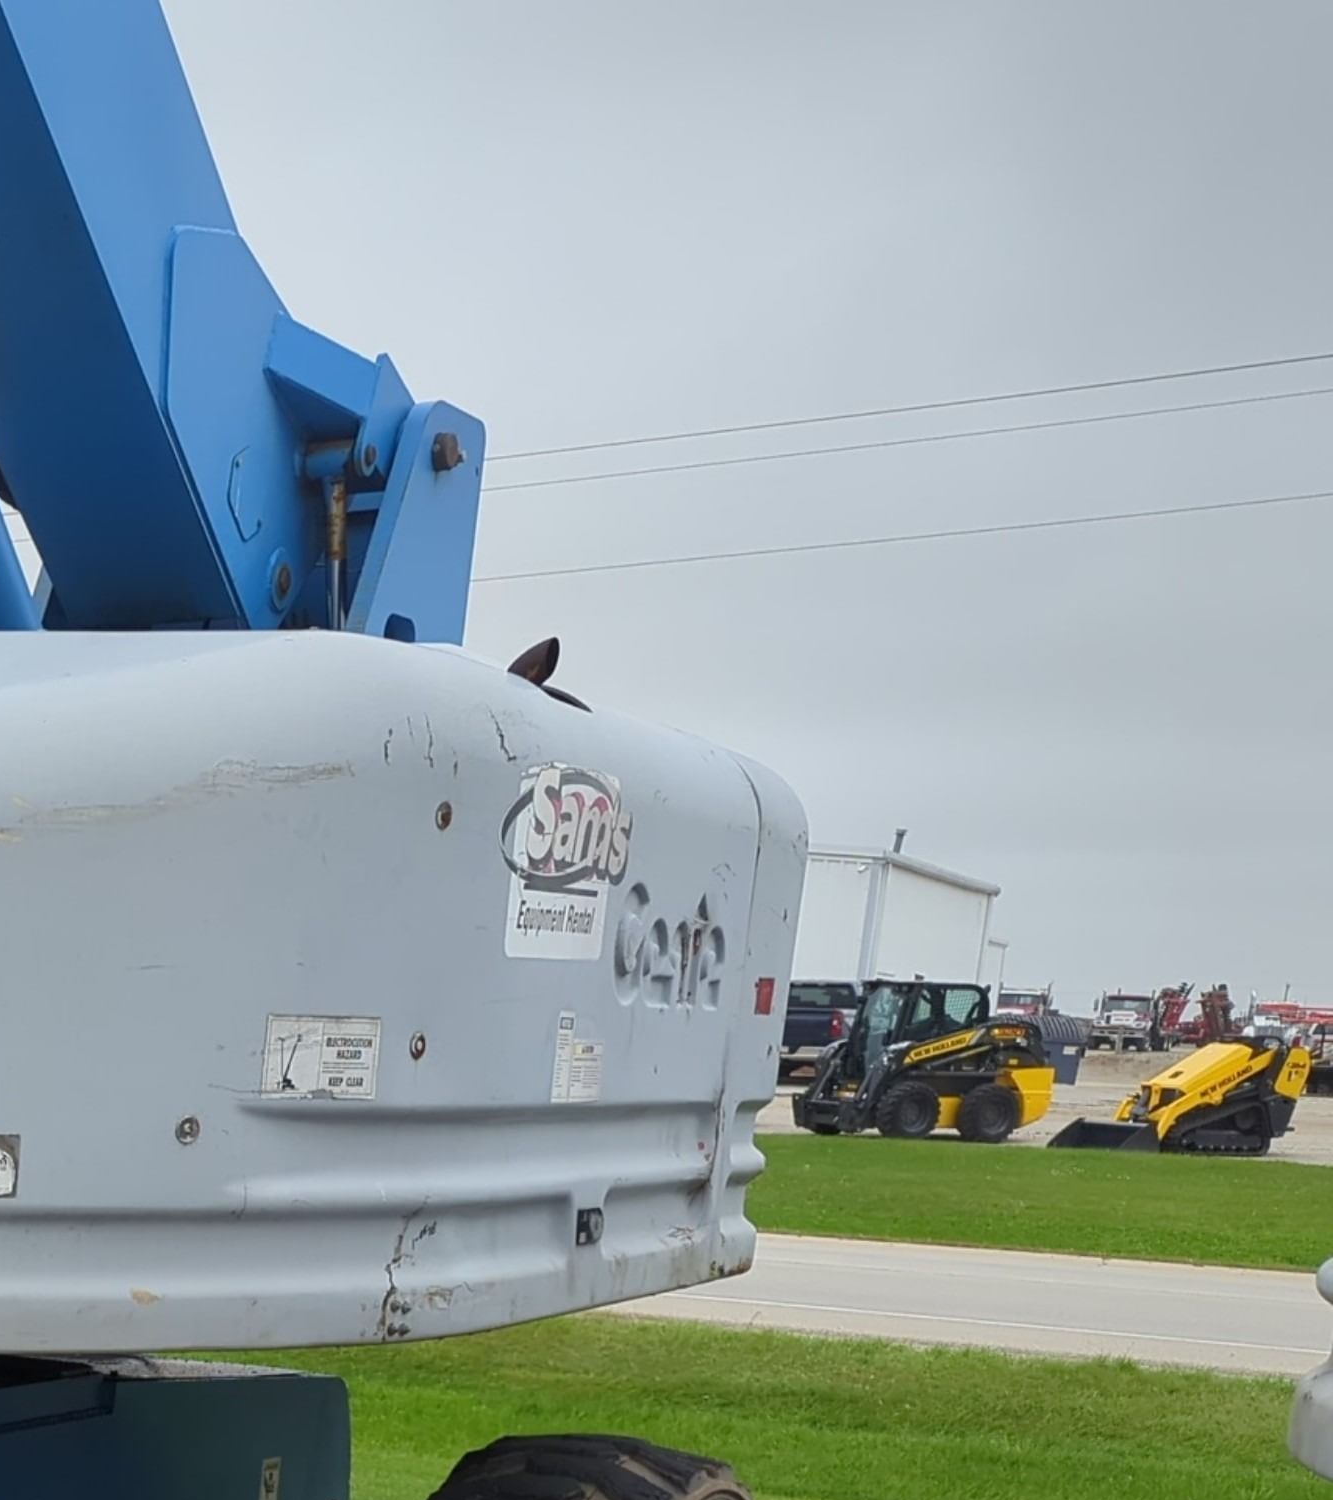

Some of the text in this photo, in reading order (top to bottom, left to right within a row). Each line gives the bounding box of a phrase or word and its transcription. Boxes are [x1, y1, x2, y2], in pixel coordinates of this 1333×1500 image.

[526, 767, 632, 884] Sam's
[517, 900, 596, 936] Equipment Rental
[336, 1050, 362, 1060] HAZARD
